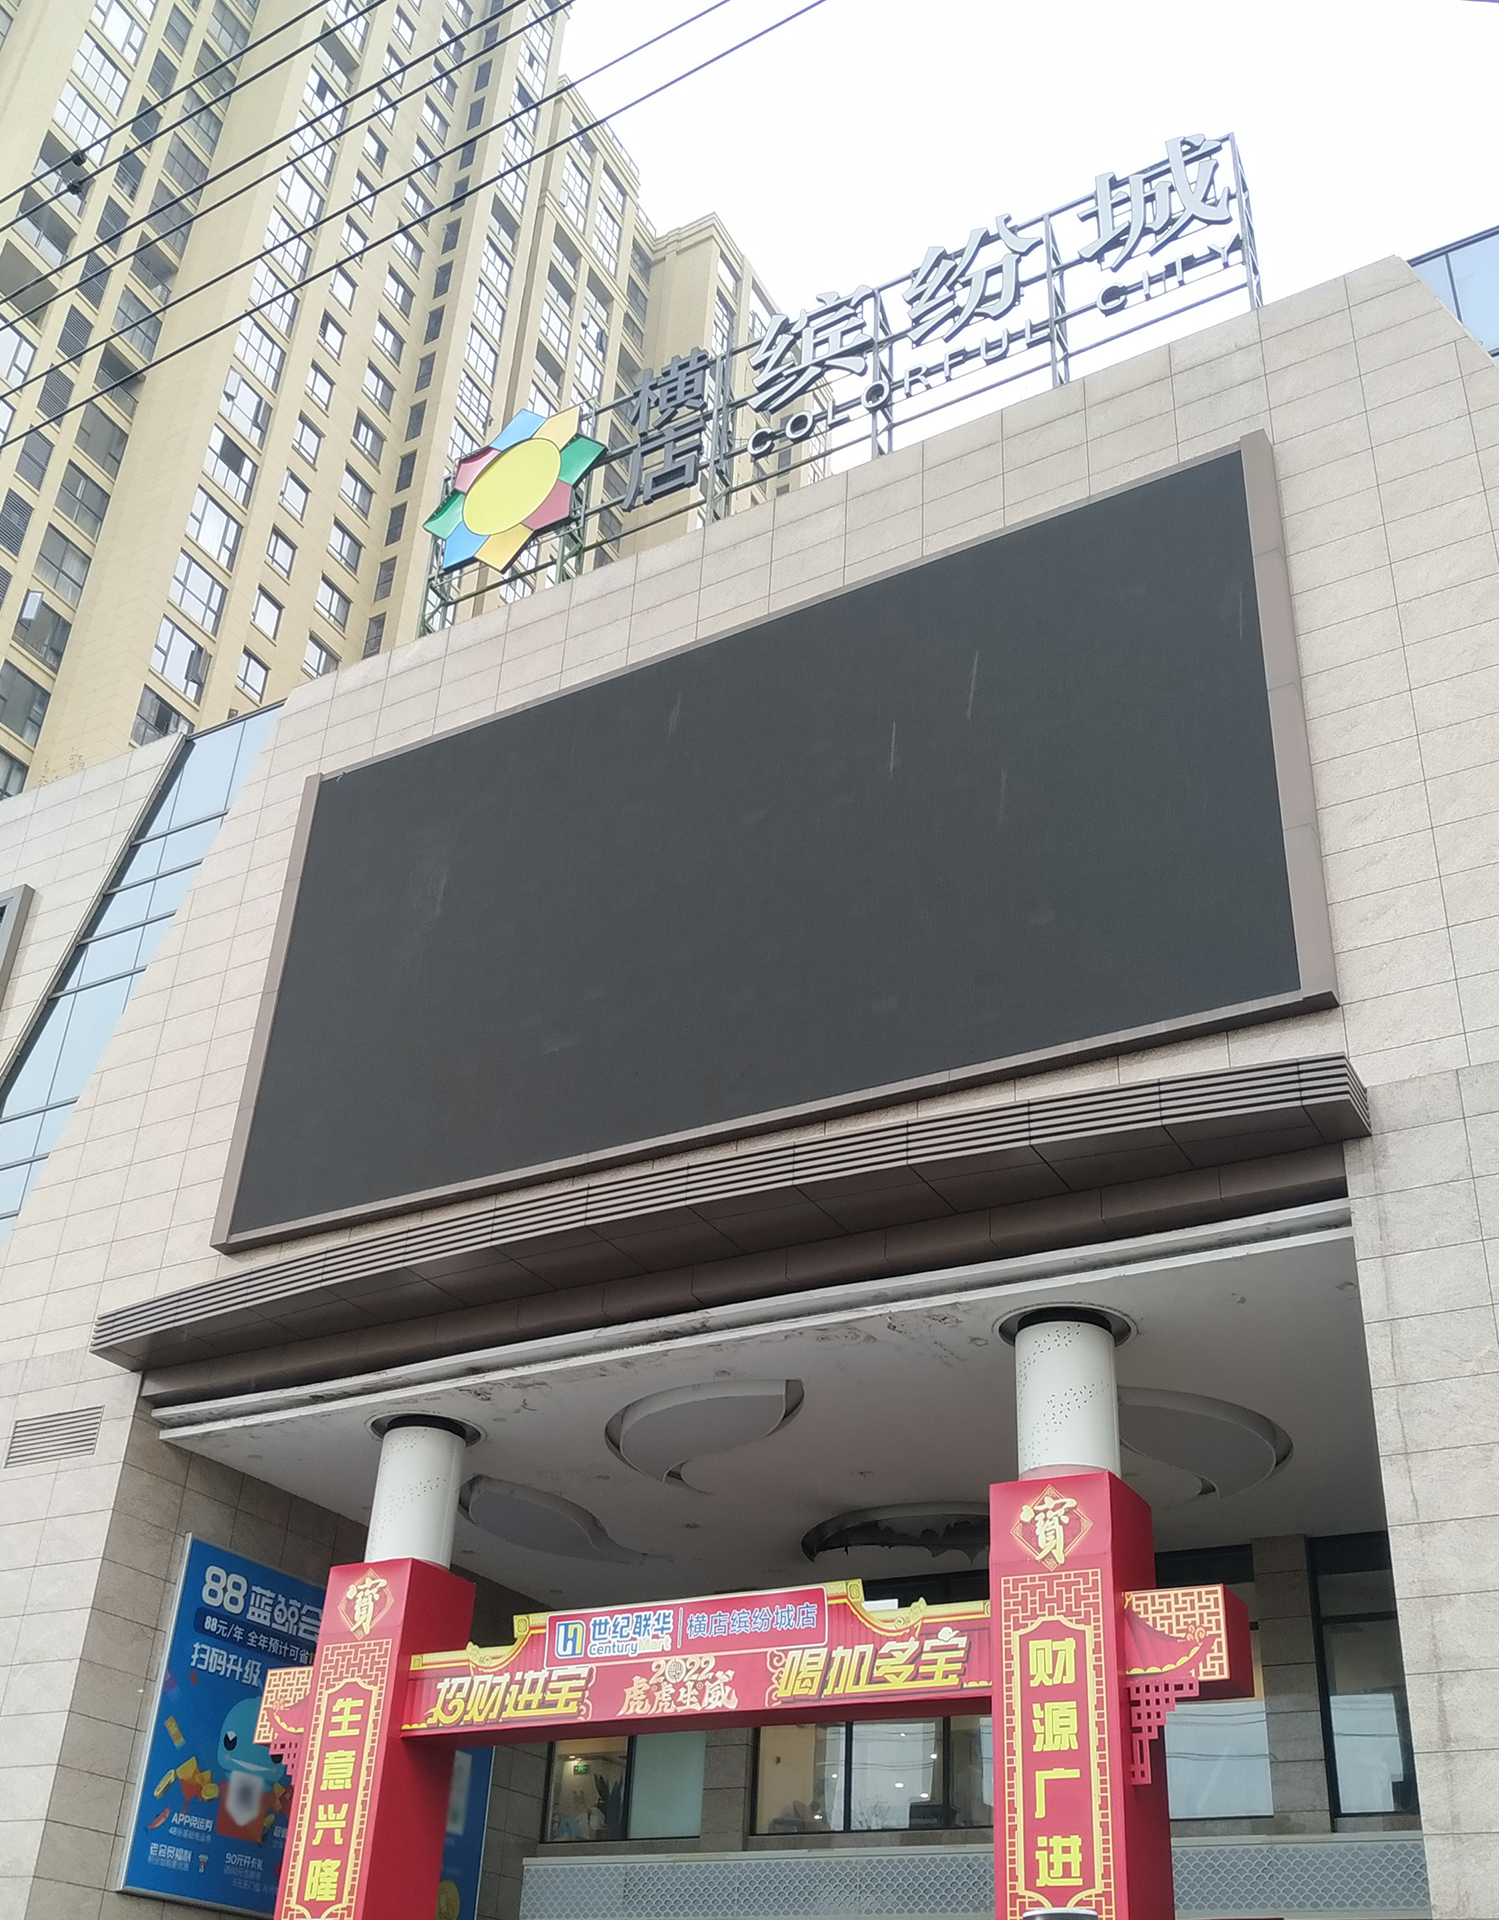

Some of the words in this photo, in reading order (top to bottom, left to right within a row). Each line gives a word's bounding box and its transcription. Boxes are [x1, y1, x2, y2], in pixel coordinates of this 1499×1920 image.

[746, 133, 1233, 417] 缤纷城
[747, 315, 1050, 458] COLORFUL
[1095, 232, 1241, 313] CITY
[621, 346, 710, 513] 横店
[190, 1641, 262, 1687] 扫码升级
[590, 1610, 674, 1642] 世纪联华
[687, 1603, 818, 1640] 横店缤纷城店
[777, 1635, 967, 1698] 喝加多宝
[616, 1669, 738, 1717] 虎虎生威
[303, 1697, 364, 1902] 生意兴隆
[1028, 1636, 1084, 1888] 财源广进
